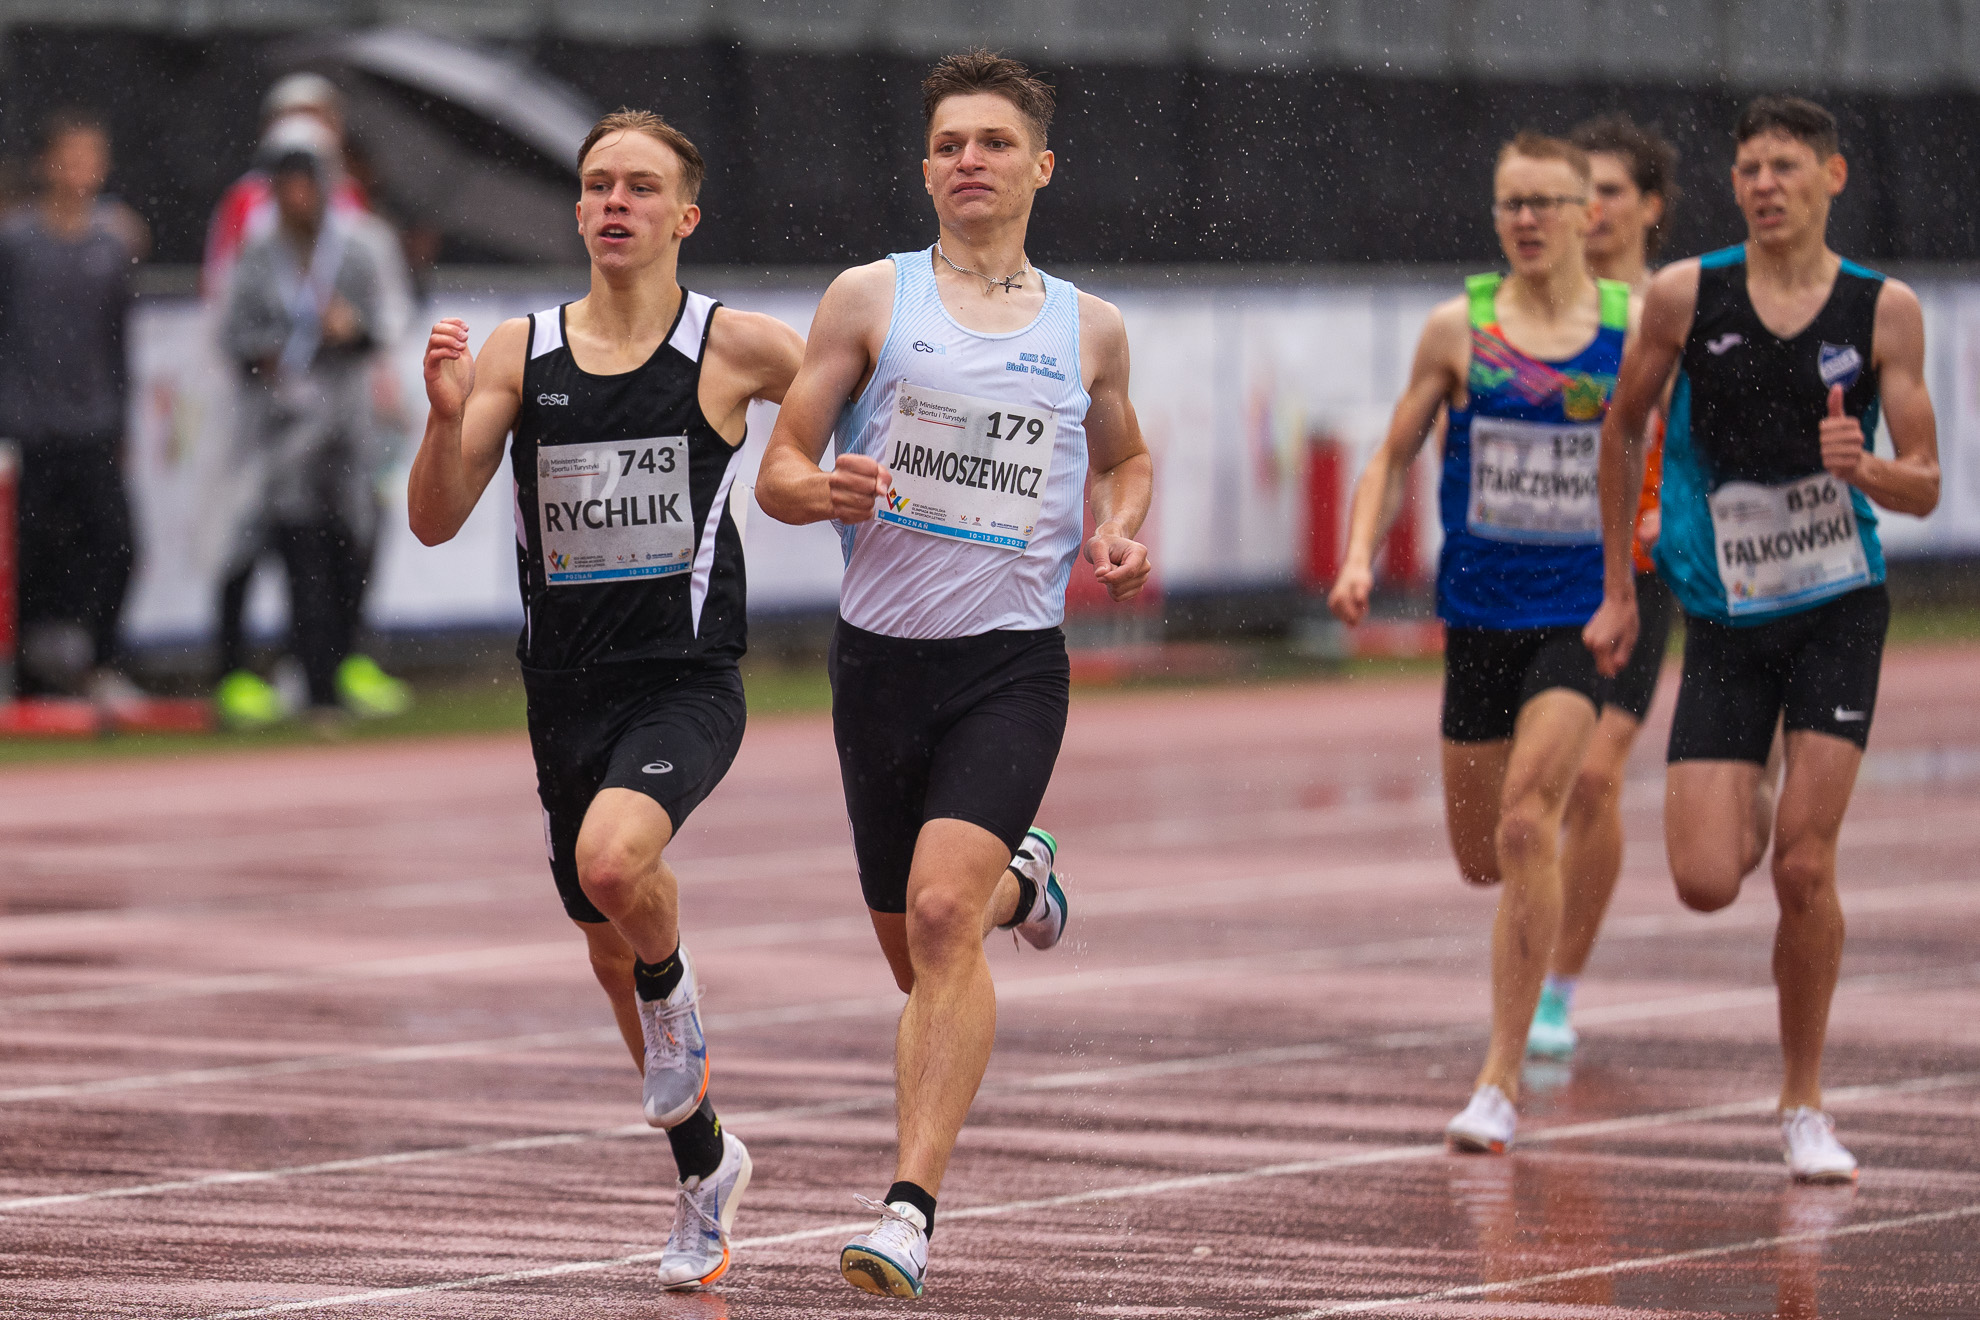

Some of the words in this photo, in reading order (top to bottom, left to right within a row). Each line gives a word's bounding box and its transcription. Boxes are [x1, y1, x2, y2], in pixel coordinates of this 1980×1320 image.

[1019, 352, 1039, 363] MKS
[1040, 353, 1057, 367] ŻAK
[1006, 361, 1029, 373] Biała
[1030, 365, 1066, 381] Podlaska
[537, 393, 569, 406] esa
[919, 401, 957, 413] Ministerstwo
[918, 408, 938, 418] Sportu
[942, 412, 968, 423] Turystyki
[986, 411, 1045, 445] 179
[550, 457, 587, 466] Ministerstwo
[573, 463, 600, 471] Turystyki
[617, 446, 676, 477] 743
[889, 440, 1043, 499] JARMOSZEWICZ
[544, 493, 684, 532] RYCHLIK
[897, 517, 929, 530] POZNAŃ
[1723, 511, 1852, 568] FALKOWSKI
